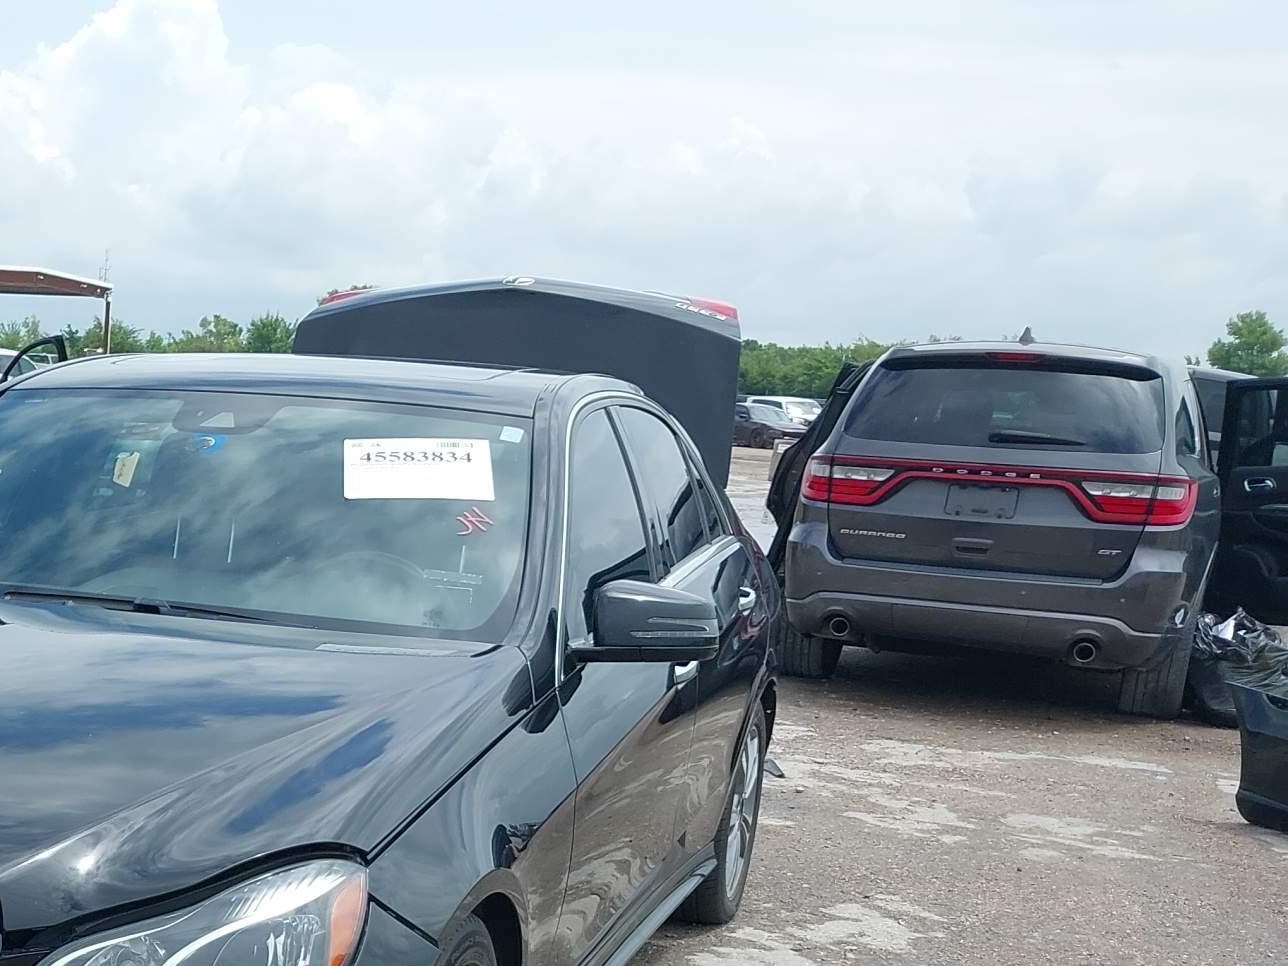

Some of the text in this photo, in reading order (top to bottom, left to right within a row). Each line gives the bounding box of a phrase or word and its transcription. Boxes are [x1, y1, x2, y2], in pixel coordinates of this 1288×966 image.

[359, 451, 473, 463] 45583834
[931, 467, 1041, 479] DODGE
[840, 528, 906, 539] DURANGO
